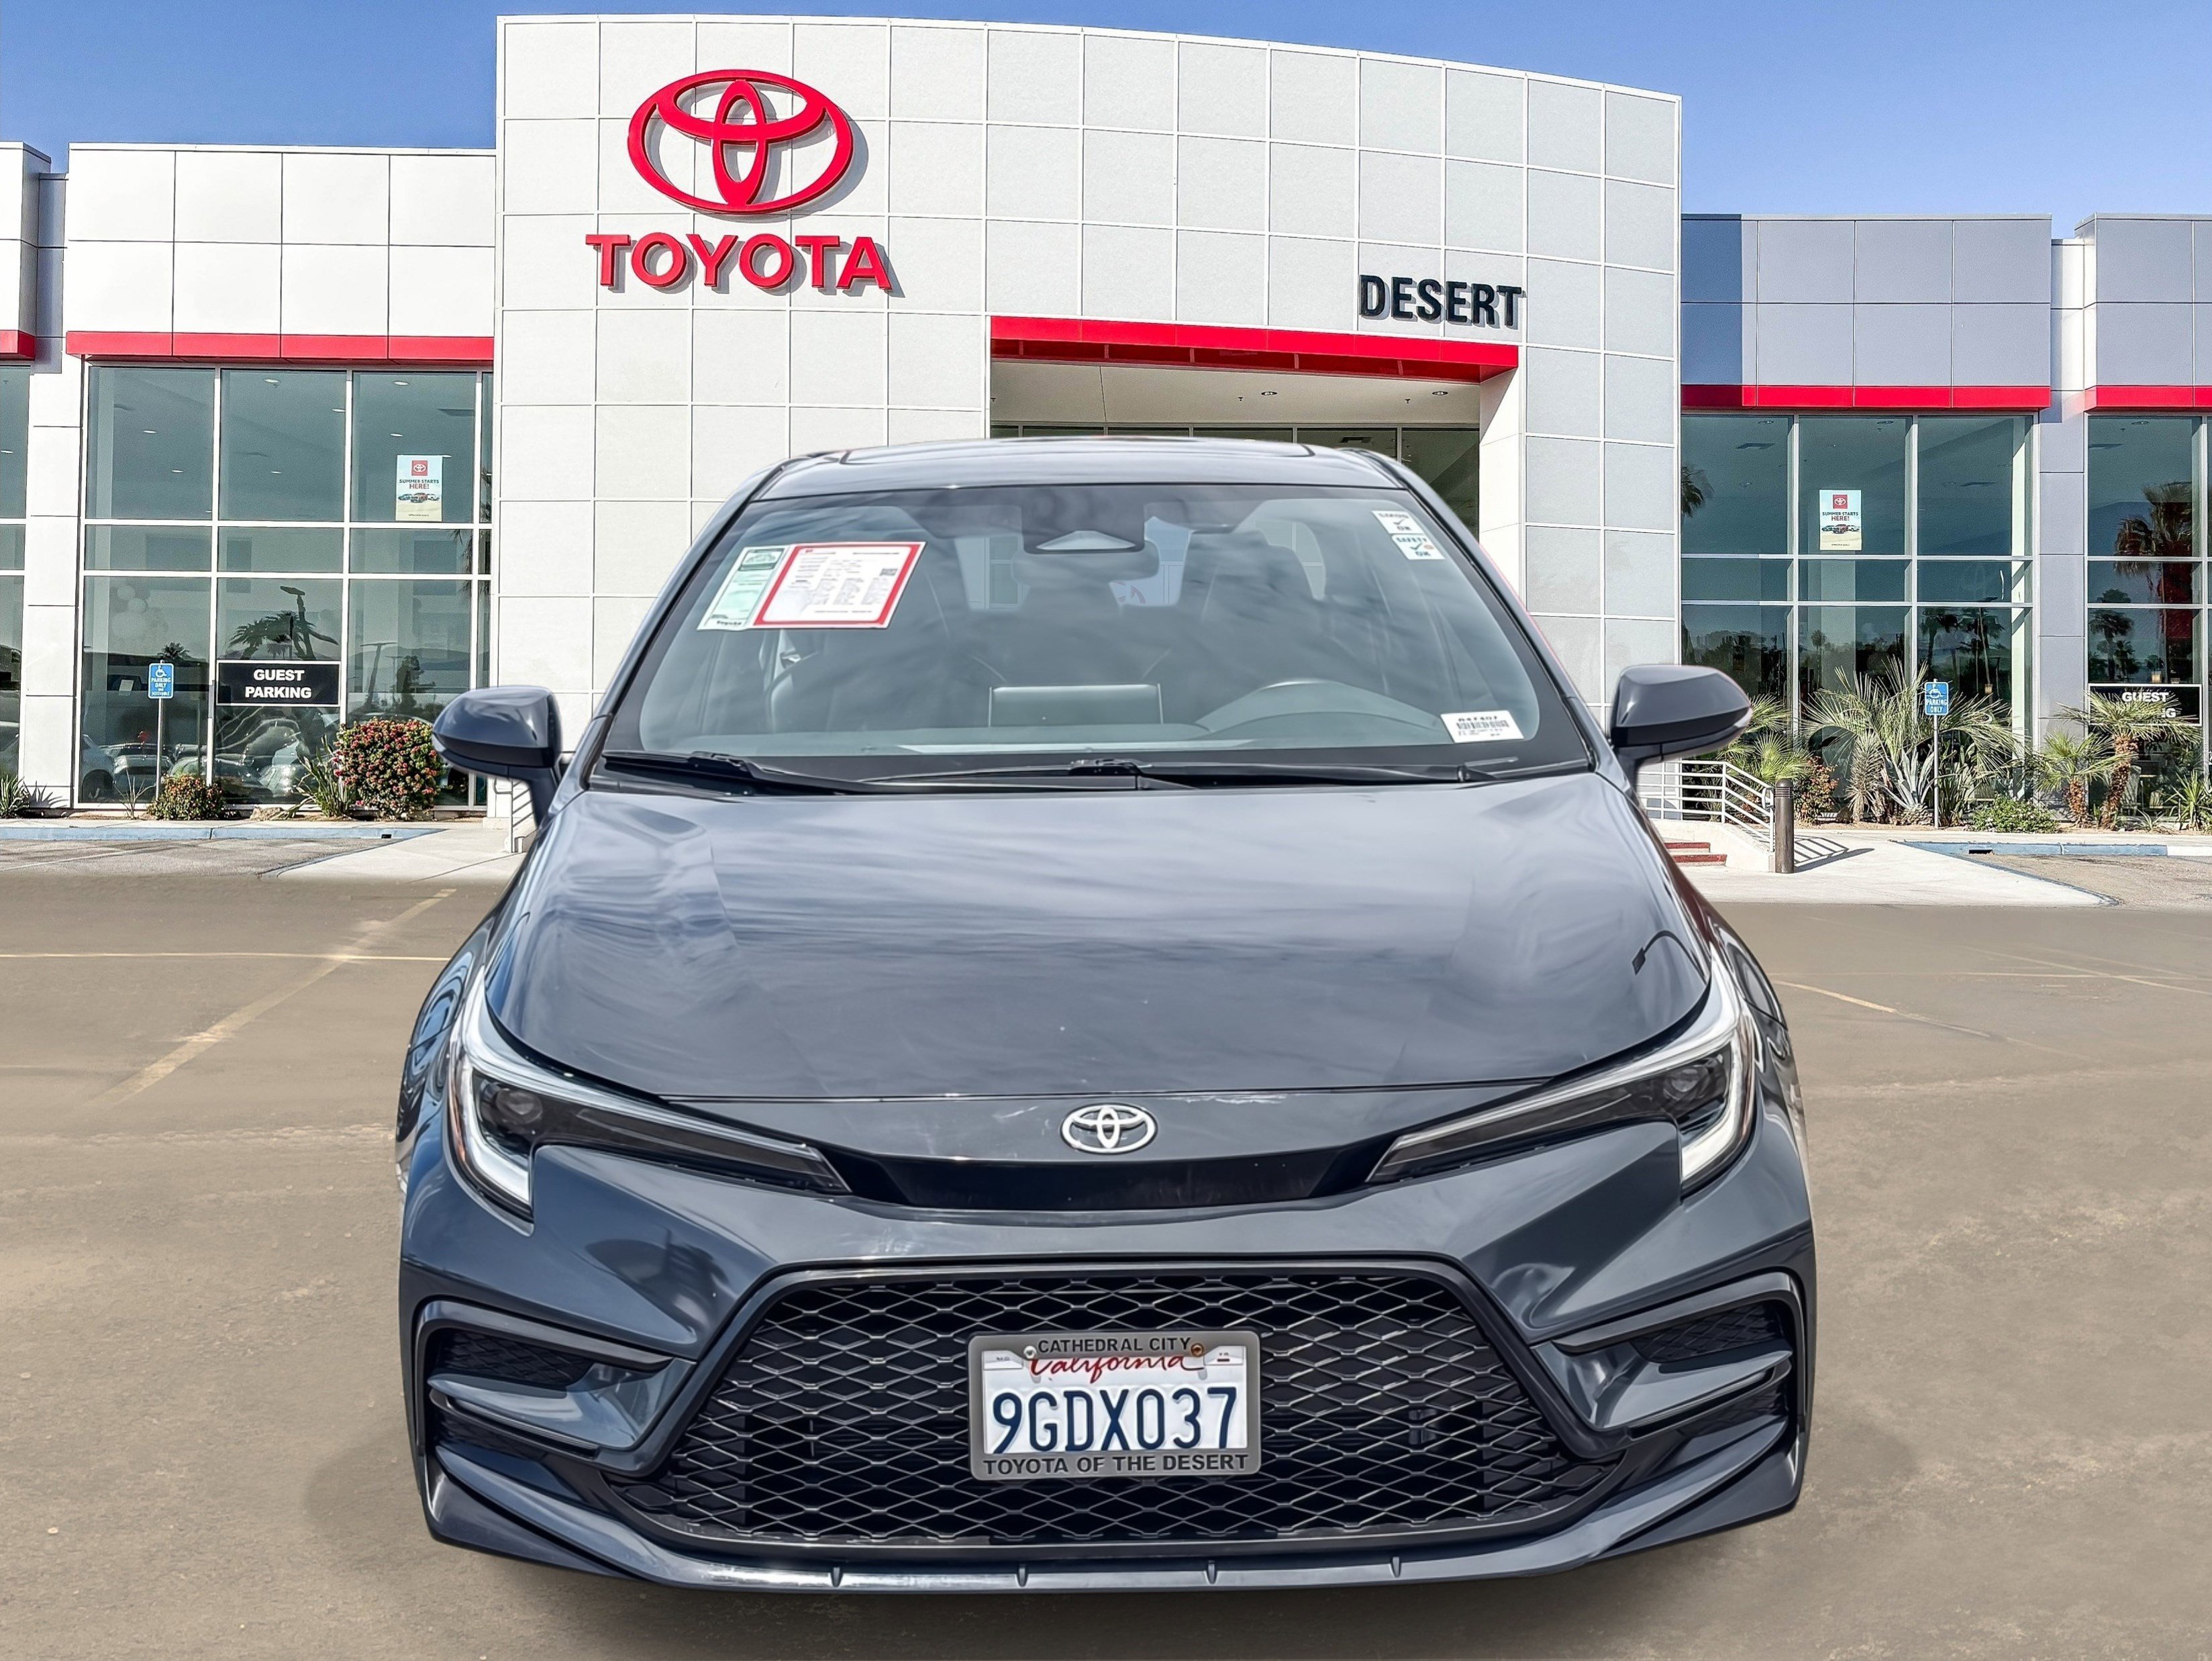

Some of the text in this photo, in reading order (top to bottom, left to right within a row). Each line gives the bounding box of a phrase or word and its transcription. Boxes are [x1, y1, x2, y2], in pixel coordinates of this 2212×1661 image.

[585, 232, 893, 289] TOYOTA
[1359, 274, 1522, 326] DESERT
[254, 669, 305, 681] GUEST
[245, 686, 311, 699] PARKING
[2121, 691, 2169, 703] GUEST
[1038, 1337, 1191, 1353] CATHEDRAL CITY
[1030, 1354, 1205, 1384] California
[993, 1387, 1237, 1454] 9GDX037
[983, 1454, 1249, 1475] TOYOTA OF THE DESERT
